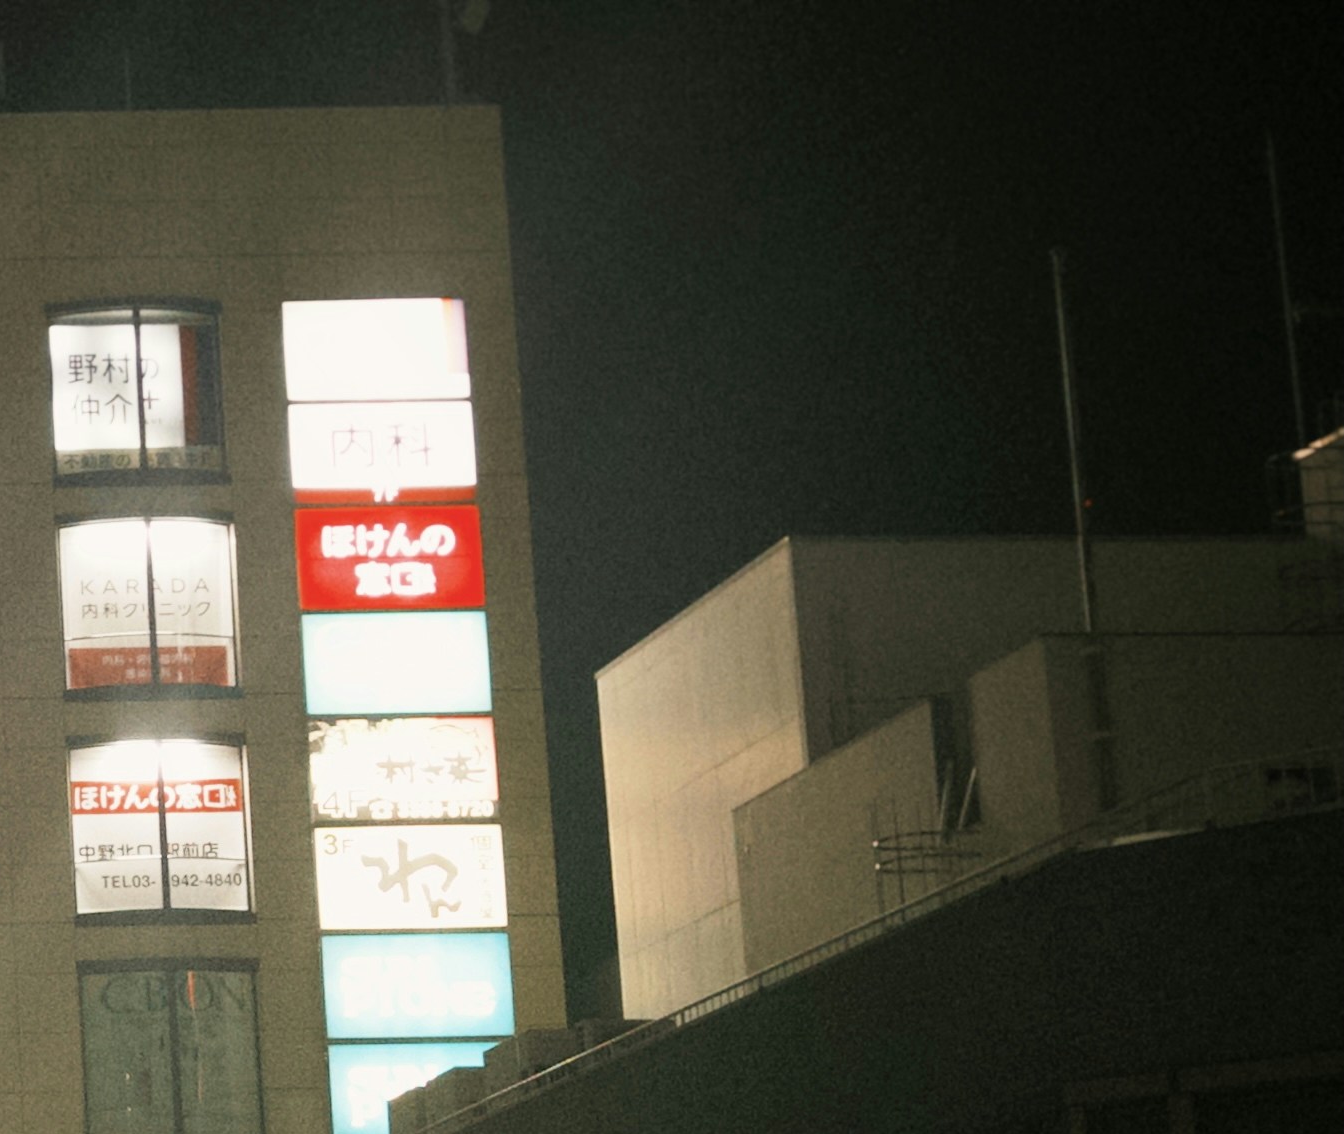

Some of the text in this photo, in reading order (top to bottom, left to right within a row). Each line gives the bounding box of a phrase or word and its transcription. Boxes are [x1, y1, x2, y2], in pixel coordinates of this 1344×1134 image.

[68, 353, 159, 385] 野村の
[331, 423, 431, 468] 内科
[320, 522, 456, 559] ほけんの
[80, 578, 210, 595] KARADA
[74, 782, 227, 812] ほけんの窓口
[79, 842, 219, 863] 中野北口駅前店
[323, 833, 354, 856] 3F
[102, 873, 243, 890] TEL03-942-4840
